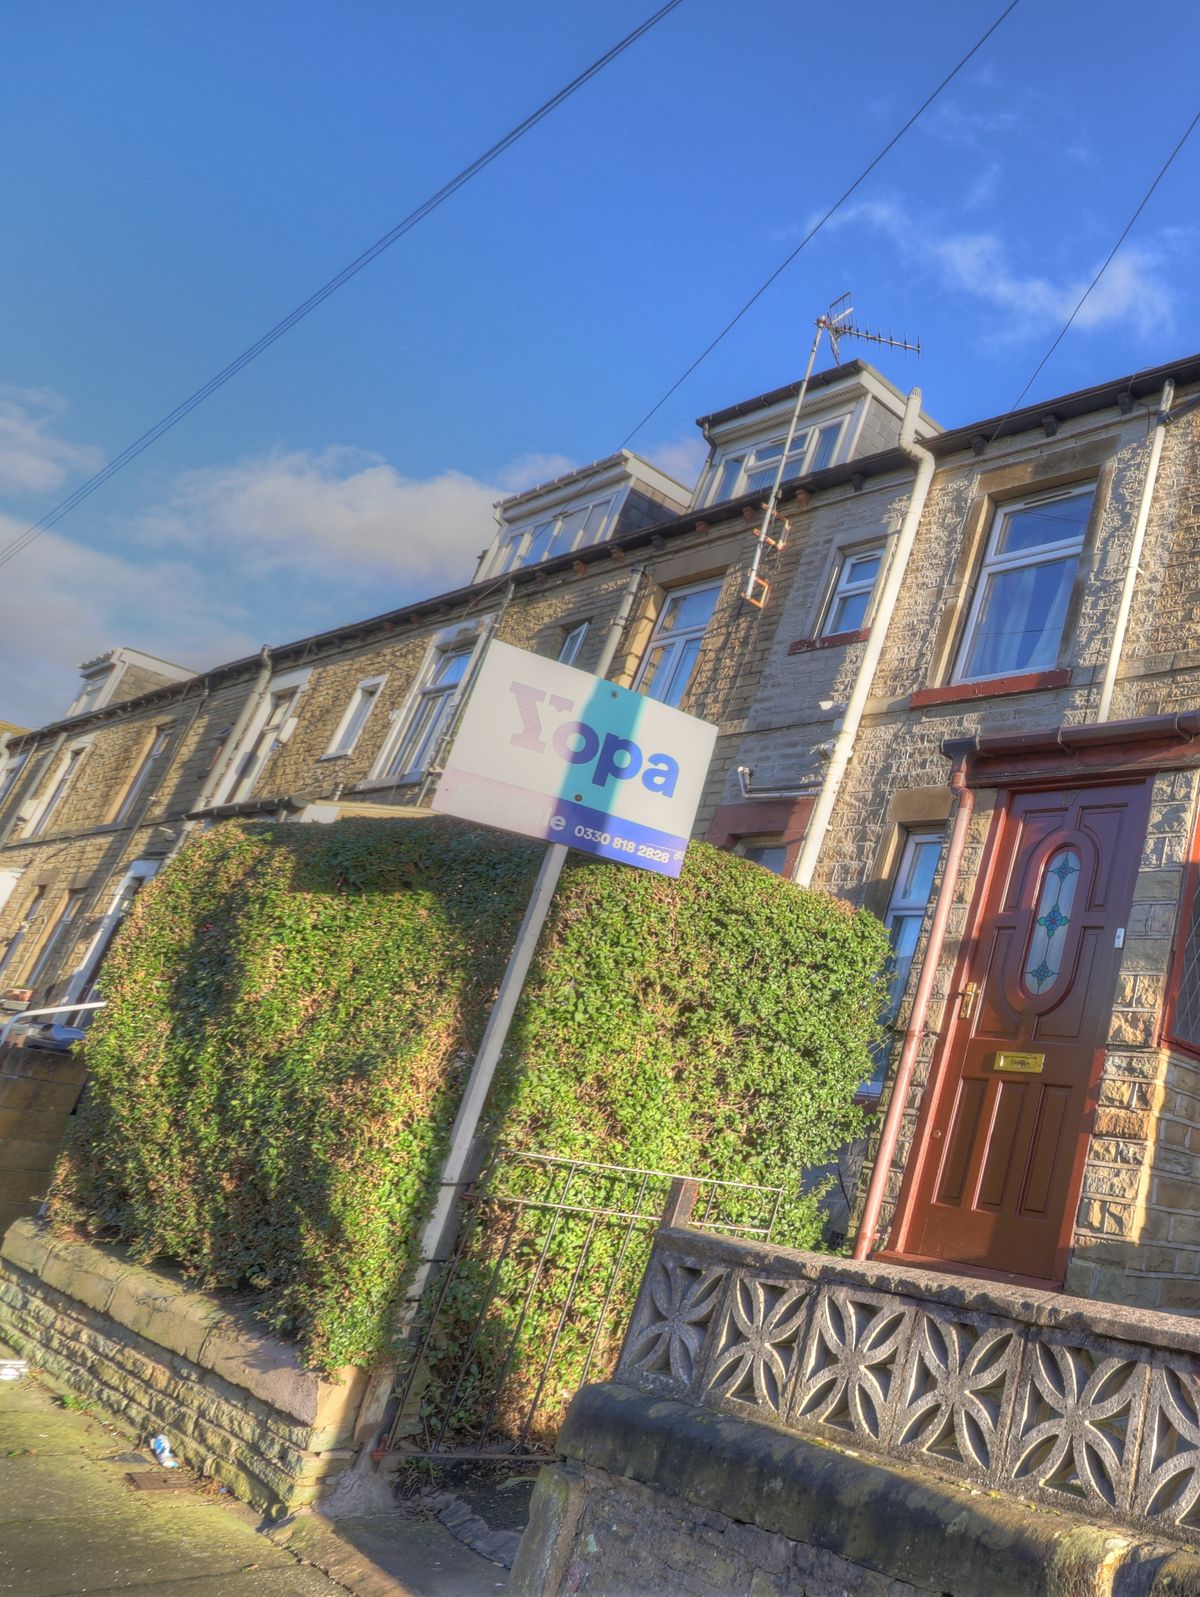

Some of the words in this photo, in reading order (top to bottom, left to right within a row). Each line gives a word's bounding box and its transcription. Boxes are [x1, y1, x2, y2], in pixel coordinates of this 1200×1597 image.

[509, 680, 680, 798] Yopa
[574, 825, 611, 845] 0330
[611, 836, 636, 853] 818
[636, 844, 670, 863] 2828
